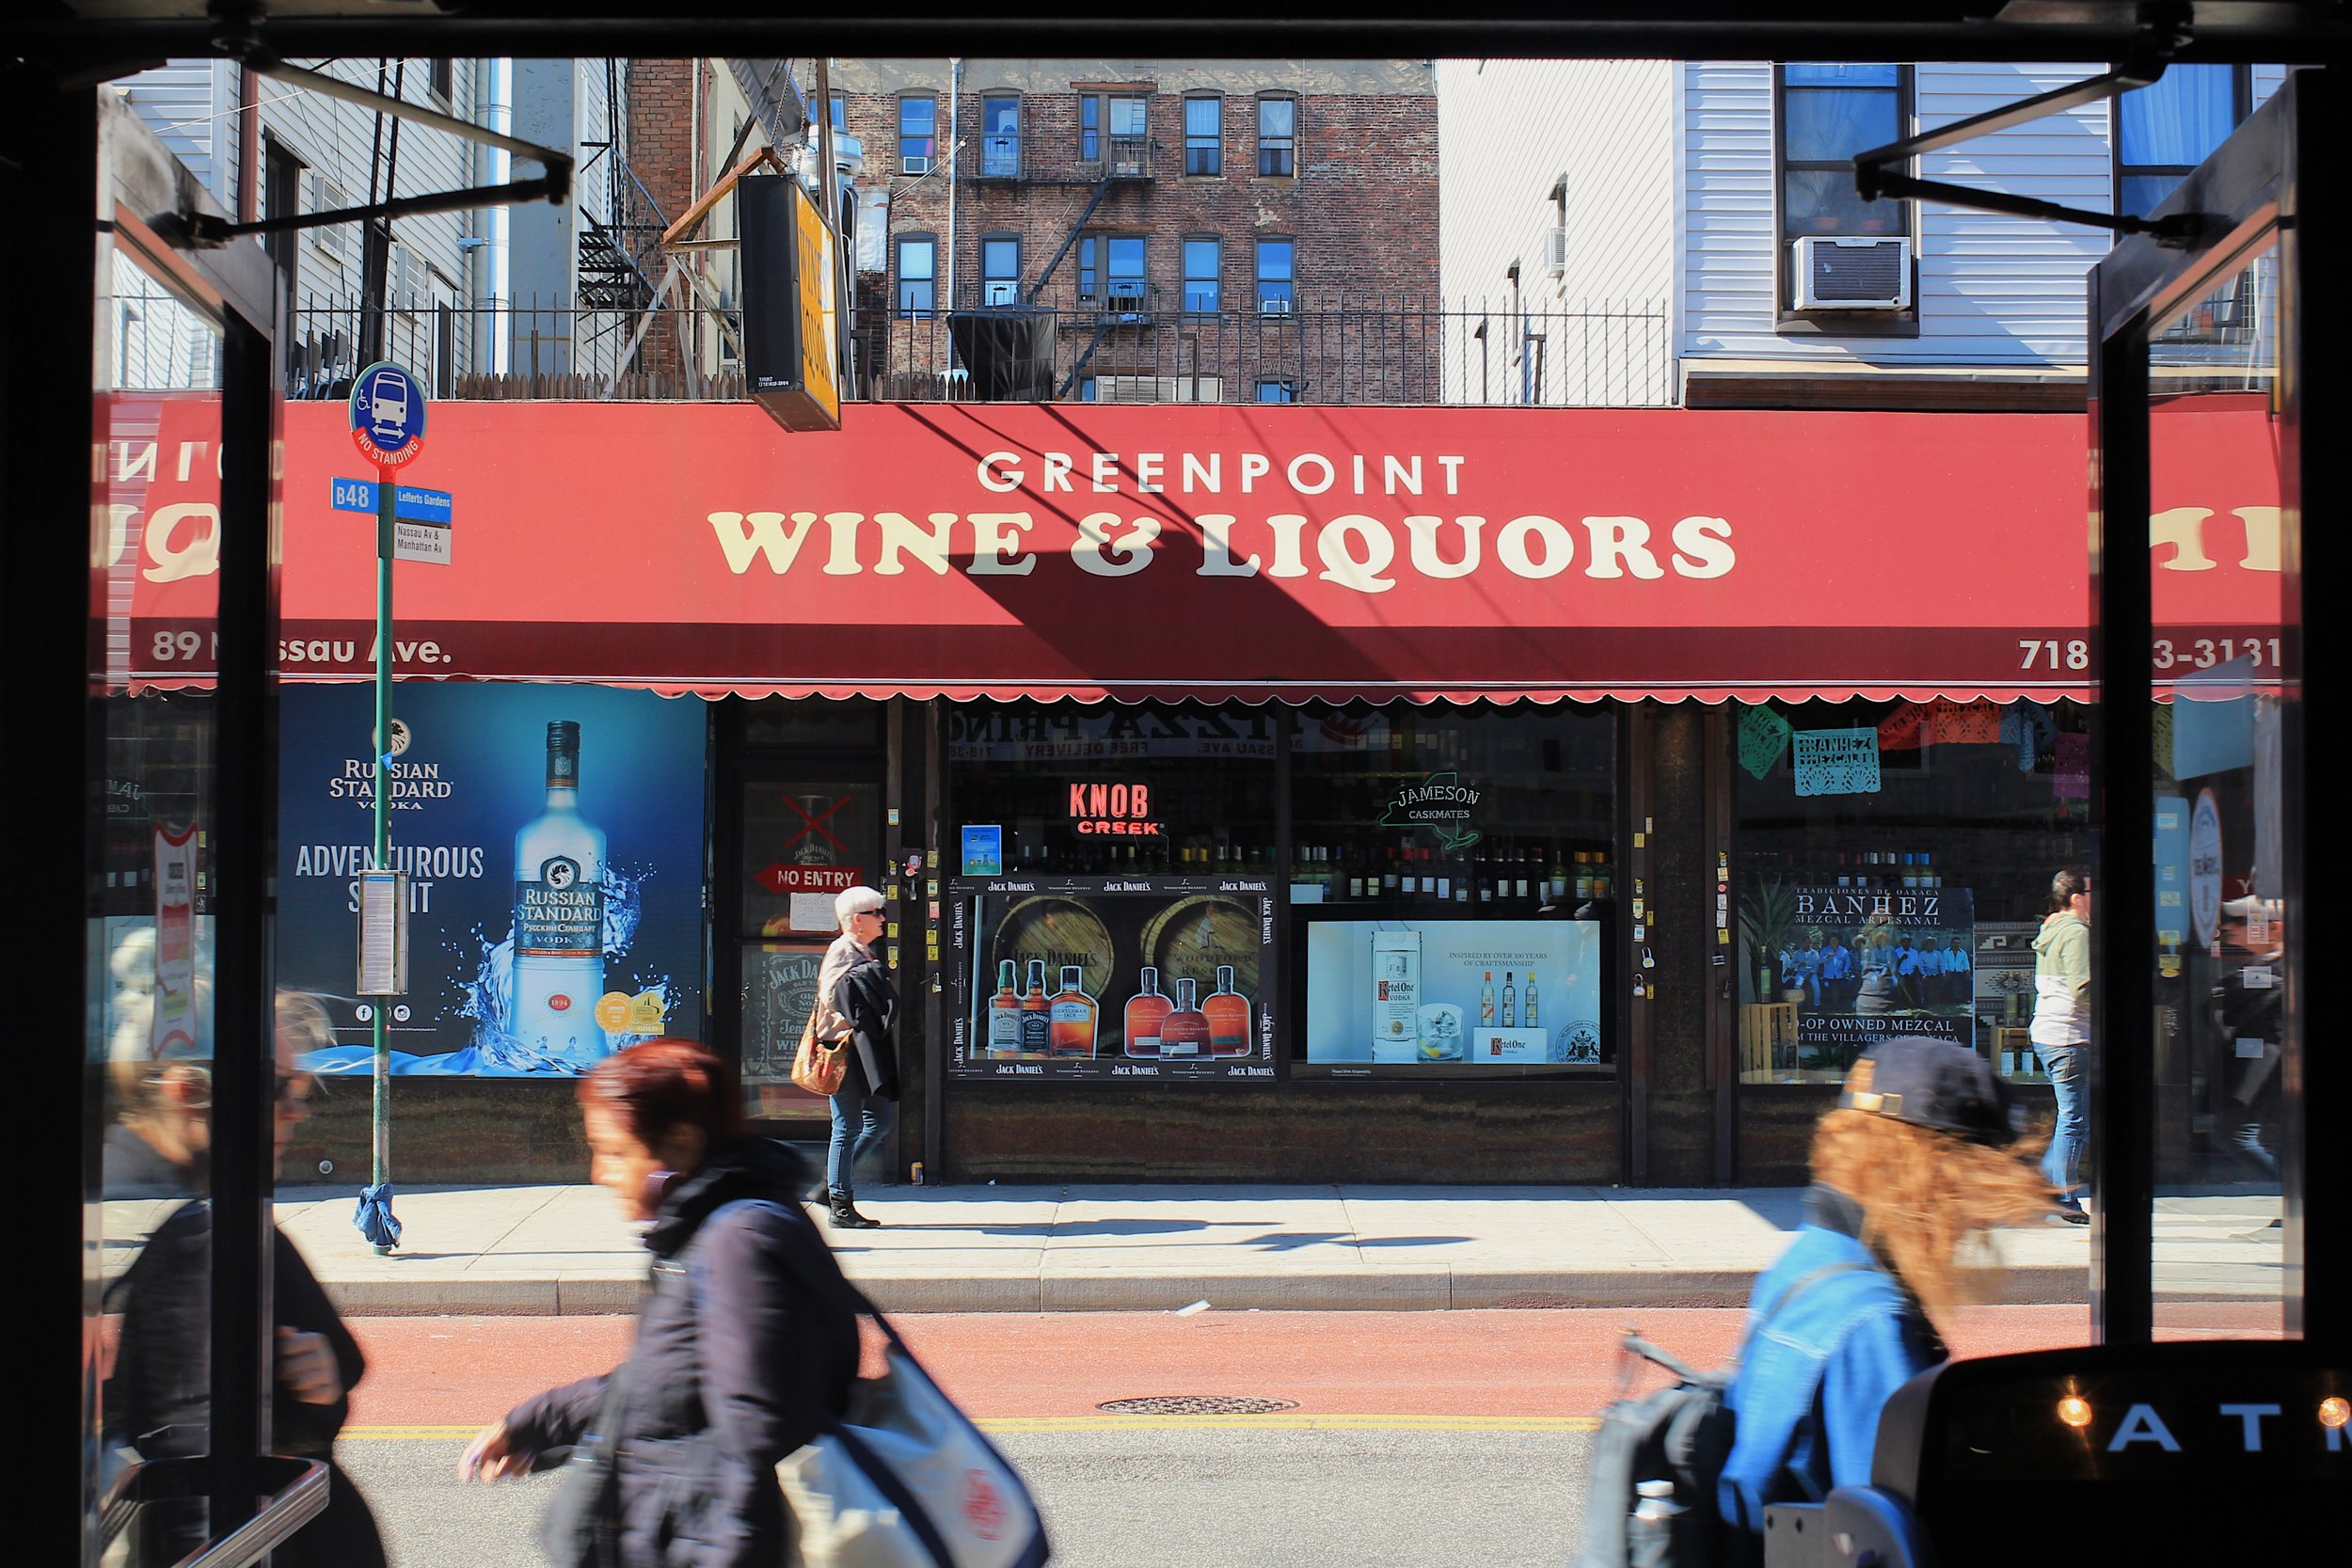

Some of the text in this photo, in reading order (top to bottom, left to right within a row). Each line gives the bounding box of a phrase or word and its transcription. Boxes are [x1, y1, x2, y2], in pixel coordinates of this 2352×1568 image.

[358, 433, 420, 465] NO STANDING
[977, 451, 1465, 497] GREENPOINT
[336, 484, 370, 509] B48
[398, 490, 451, 508] Lefferts Gardens
[397, 525, 439, 540] Nassau Av &
[397, 538, 442, 553] Manhattan Av
[707, 511, 1737, 594] WINE & LIQUORS
[152, 630, 201, 661] 89
[2019, 638, 2281, 671] 7183-3131
[344, 759, 438, 779] RUSIAN
[329, 778, 452, 798] STADARD
[1398, 785, 1481, 807] JAMESON
[1070, 783, 1148, 818] KNOB
[1408, 810, 1470, 819] CASKMATES
[1077, 821, 1159, 835] CREEK
[295, 845, 485, 879] ADVENUROUS
[777, 869, 855, 887] NO ENTRY
[988, 881, 1035, 892] JACK DANIEL'S
[1103, 881, 1152, 892] JACK DANIEL'S
[1218, 880, 1267, 892] JACK DANIEL'S
[348, 881, 434, 913] SIT
[526, 888, 596, 906] RUSSIAN
[1795, 895, 1939, 916] BANHEZ
[516, 903, 602, 922] STANDARD
[1263, 897, 1273, 944] JACK DANIEL'S
[1795, 915, 1941, 926] MEZCAL ARTESANAL
[953, 901, 963, 949] JACK DANIEL'S
[535, 936, 583, 944] VODKA
[770, 963, 801, 990] JACK
[1182, 966, 1245, 974] RESEE
[1377, 980, 1414, 1001] Ketel One
[953, 1017, 964, 1045] DANIEL'S
[1797, 1018, 1954, 1032] -OP OWNED MEZCAL
[1263, 1033, 1273, 1061] DANIEL'S
[1490, 1037, 1526, 1055] Ketel One
[1806, 1033, 1828, 1041] THE
[1831, 1033, 1892, 1042] VILLAGERS
[996, 1064, 1044, 1074] JACK DANIEL'S
[1111, 1065, 1160, 1075] JACK DANIEL'S
[1228, 1066, 1276, 1077] JACK DANIEL'S
